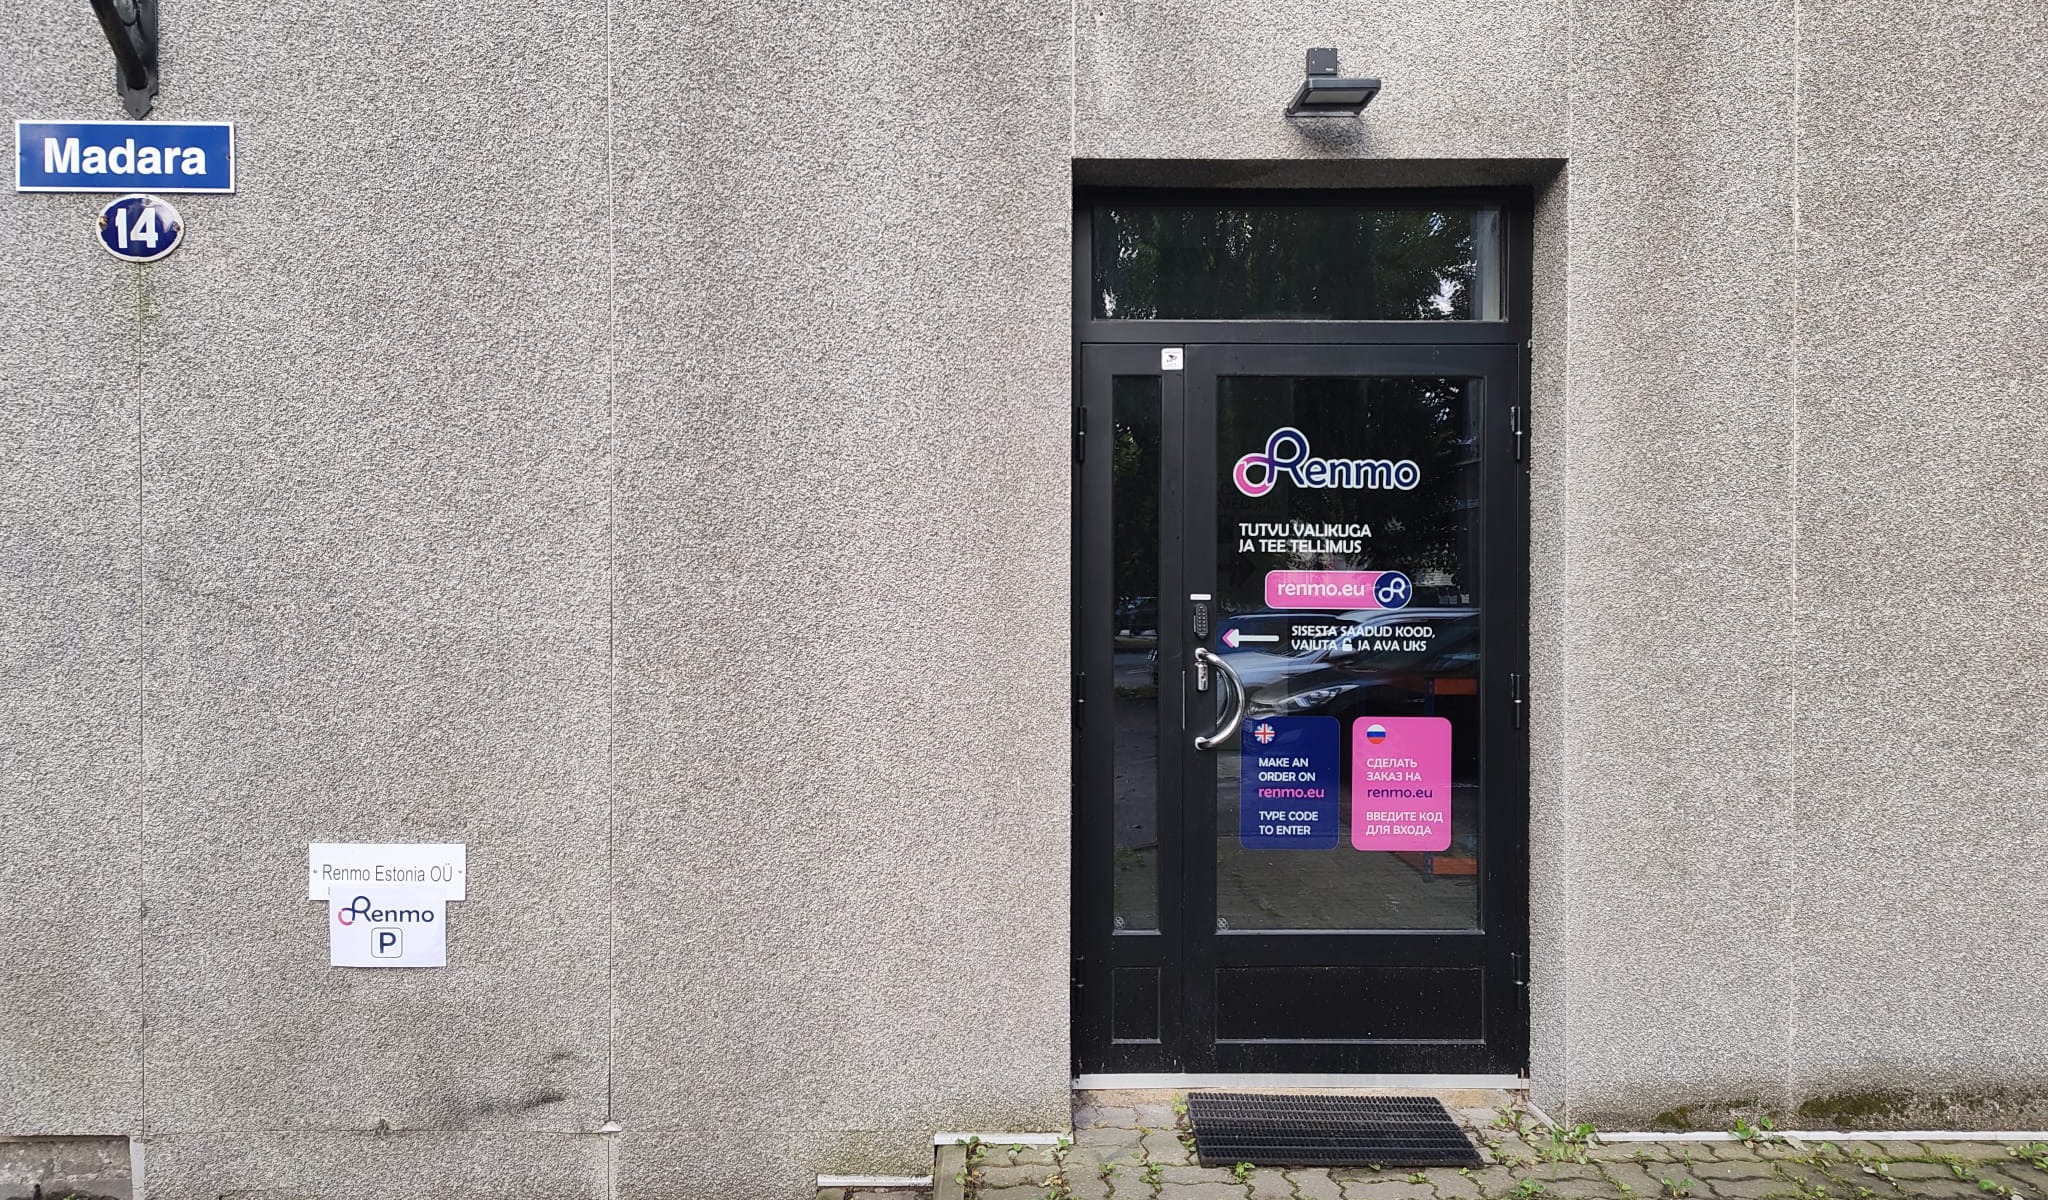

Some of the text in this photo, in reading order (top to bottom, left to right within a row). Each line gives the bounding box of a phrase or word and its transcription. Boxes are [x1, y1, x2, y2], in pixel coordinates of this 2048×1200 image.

[44, 137, 207, 175] Madara
[115, 207, 159, 249] 14
[1233, 427, 1420, 497] Renmo
[1238, 523, 1372, 538] TUTVU VALIKUGA
[1238, 539, 1362, 554] JA TEE TELLIMUS
[1277, 582, 1365, 597] renmo.eu
[1291, 625, 1436, 639] SISESTA SAADUD KOOD,
[1291, 639, 1427, 652] VAJUTA JA AVA UKS
[1258, 757, 1309, 768] MAKE AN
[1366, 758, 1418, 769] СДЕЛАТЬ
[1258, 771, 1316, 782] ORDER ON
[1366, 771, 1422, 782] ЗАКАЗ НА
[1258, 787, 1325, 799] renmo.eu
[1367, 787, 1433, 799] renmo.eu
[1259, 811, 1319, 822] TYPE CODE
[1366, 811, 1443, 824] ВВЕДИТЕ КОД
[1259, 825, 1311, 836] TO ENTER
[1366, 825, 1432, 836] ДЛЯ ВХОДА
[322, 862, 453, 882] Renmo Estonia OÜ
[337, 895, 435, 926] Renmo
[379, 932, 397, 954] P
